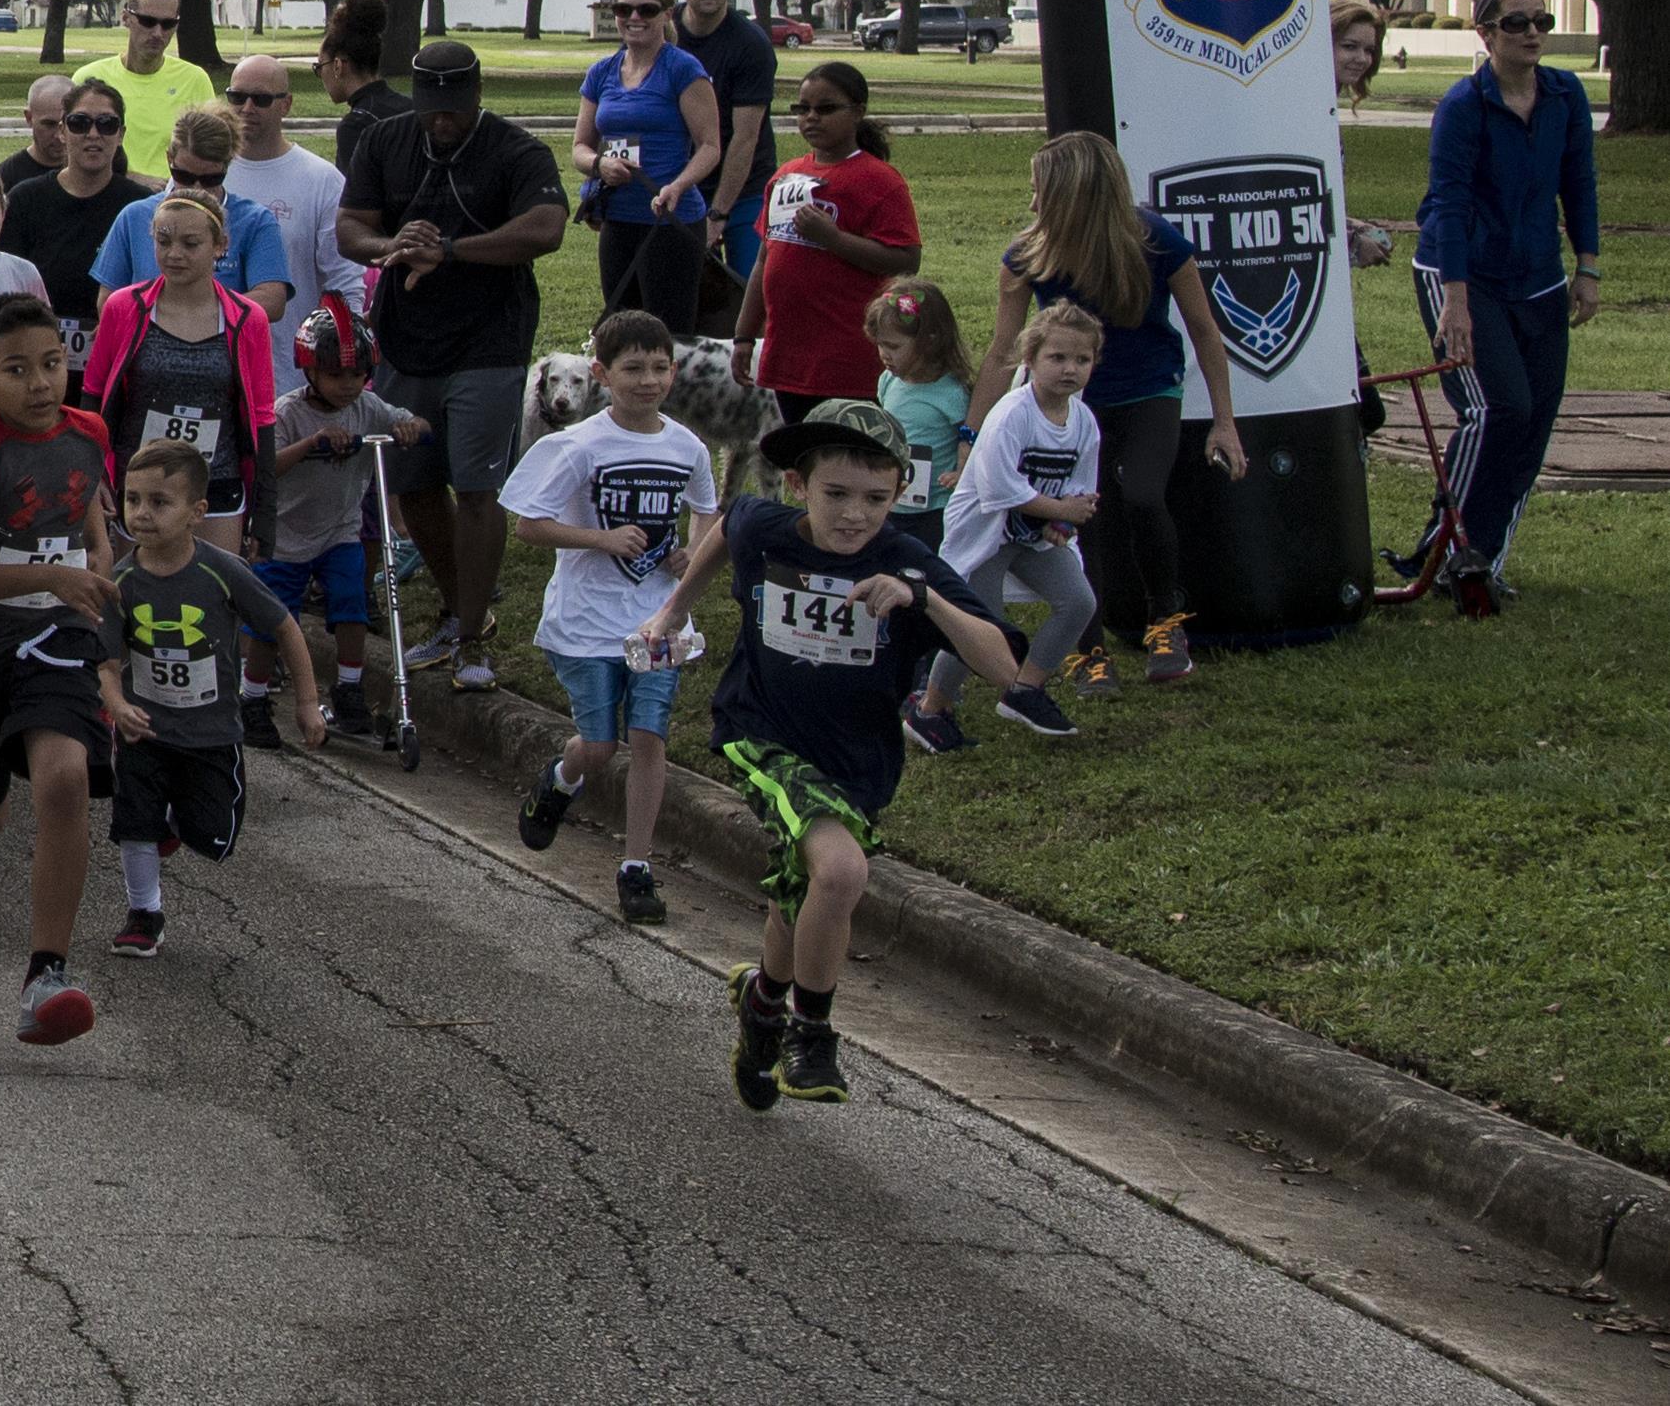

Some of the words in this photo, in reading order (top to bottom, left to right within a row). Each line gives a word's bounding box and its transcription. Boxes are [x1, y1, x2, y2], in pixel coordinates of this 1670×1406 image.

[1146, 15, 1194, 54] 359TH
[1198, 40, 1271, 76] MEDICAL
[1271, 5, 1310, 51] GROUP
[777, 183, 805, 206] 122
[1175, 194, 1206, 206] JBSA
[1218, 189, 1277, 204] RANDOLPH
[1278, 188, 1299, 200] AFB,
[1300, 186, 1311, 197] TX
[1230, 209, 1282, 249] KID
[1291, 202, 1326, 244] 5K
[1194, 259, 1221, 269] AMILY
[1232, 255, 1275, 267] NUTRITION
[1283, 252, 1313, 263] FITNESS
[165, 417, 201, 443] 85
[633, 478, 669, 486] RANDOLPH
[599, 487, 631, 512] FIT
[638, 490, 669, 514] KID
[673, 490, 684, 513] 5
[781, 591, 855, 637] 144
[150, 661, 191, 688] 58
